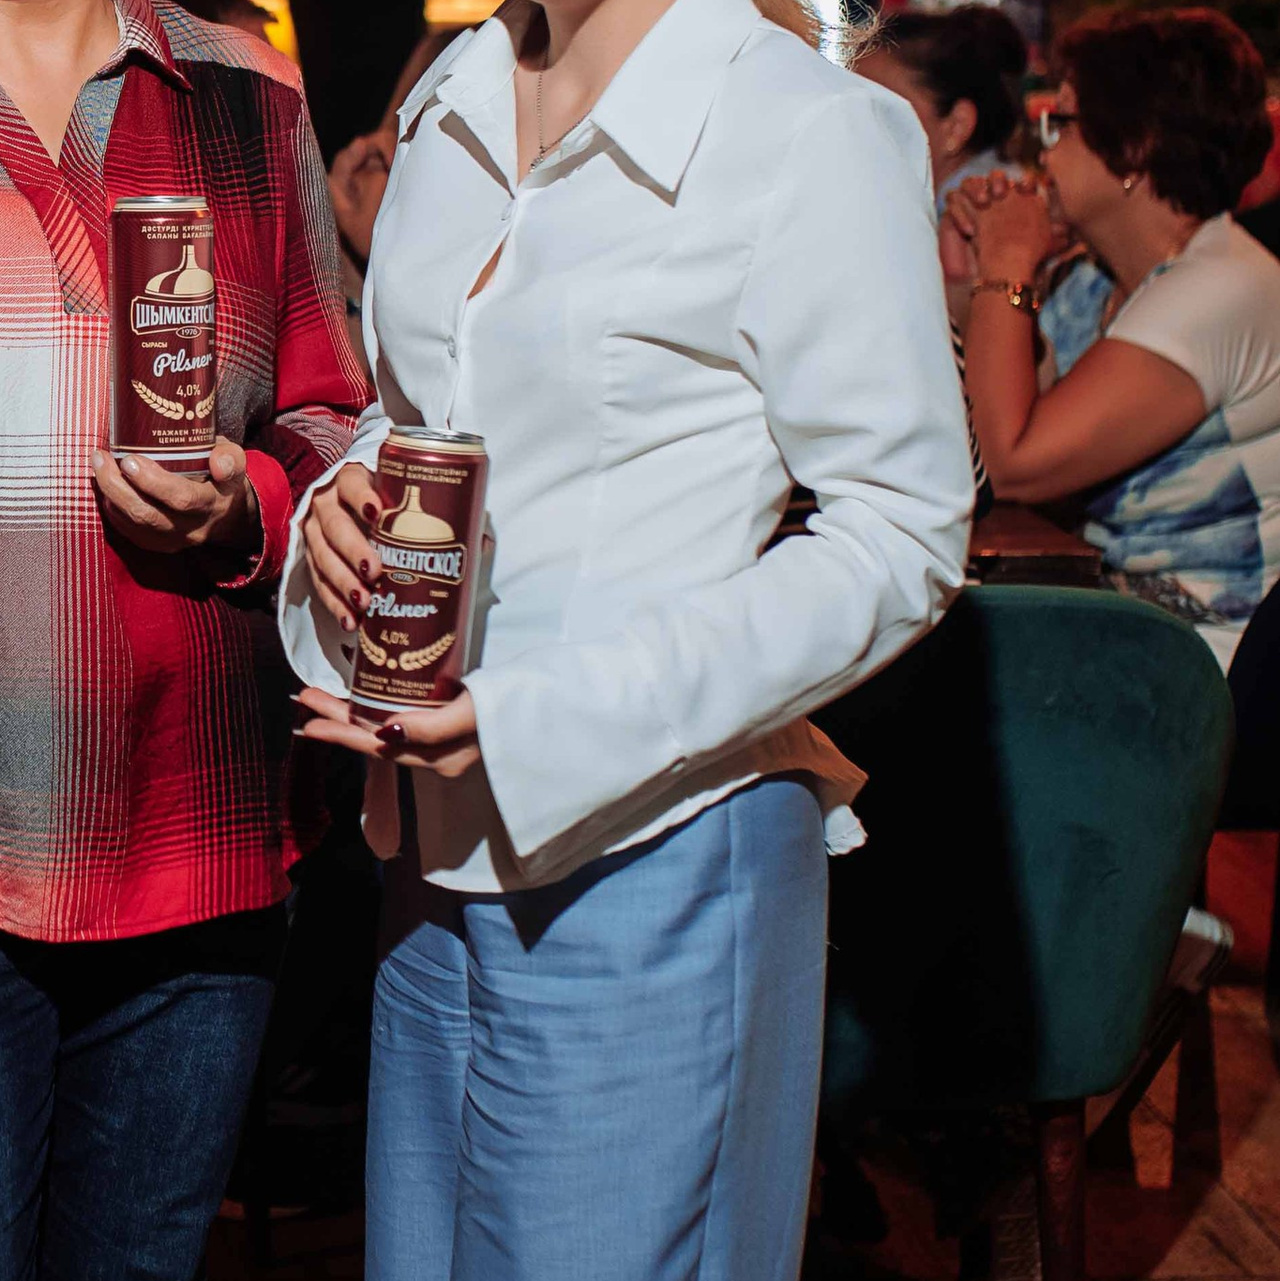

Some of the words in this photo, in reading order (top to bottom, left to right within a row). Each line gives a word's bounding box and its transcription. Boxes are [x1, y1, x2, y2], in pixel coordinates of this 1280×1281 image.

[153, 349, 213, 377] Pilsner
[176, 384, 201, 398] 4,0%
[158, 436, 186, 444] ЦЕНИМ
[367, 592, 438, 618] Pilsner
